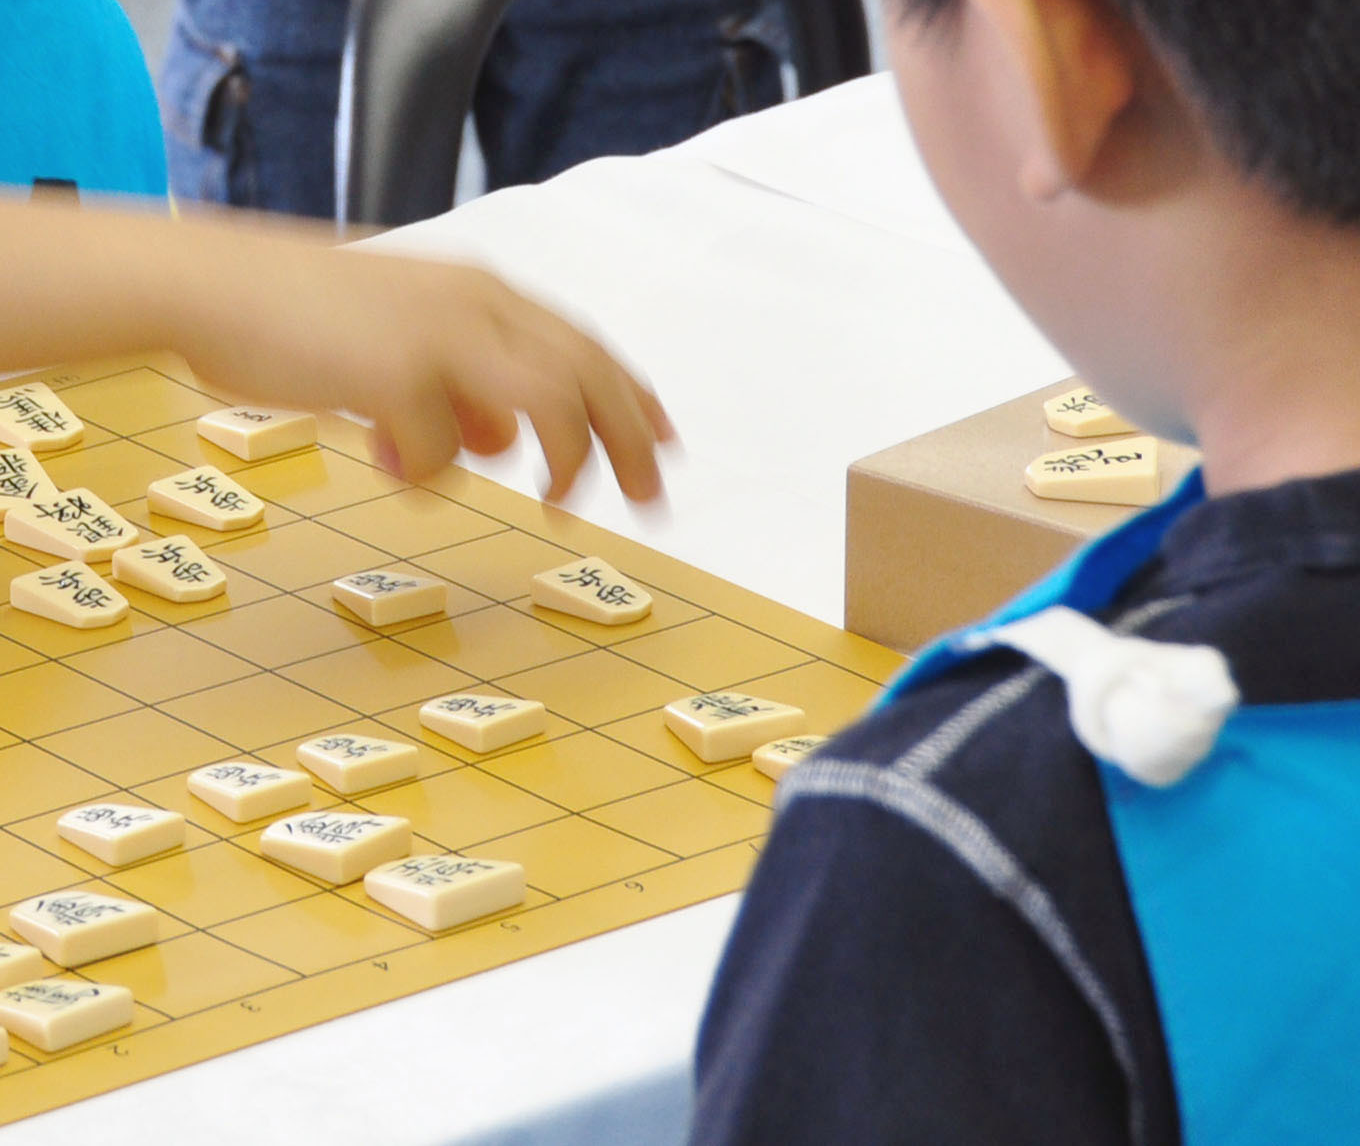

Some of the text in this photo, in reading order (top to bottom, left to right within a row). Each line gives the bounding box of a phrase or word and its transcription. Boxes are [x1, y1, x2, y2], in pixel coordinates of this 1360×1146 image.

[174, 474, 248, 512] 歩兵
[141, 544, 211, 584] 歩兵
[39, 569, 114, 610] 歩兵
[559, 566, 639, 607] 歩兵
[623, 880, 646, 894] 6
